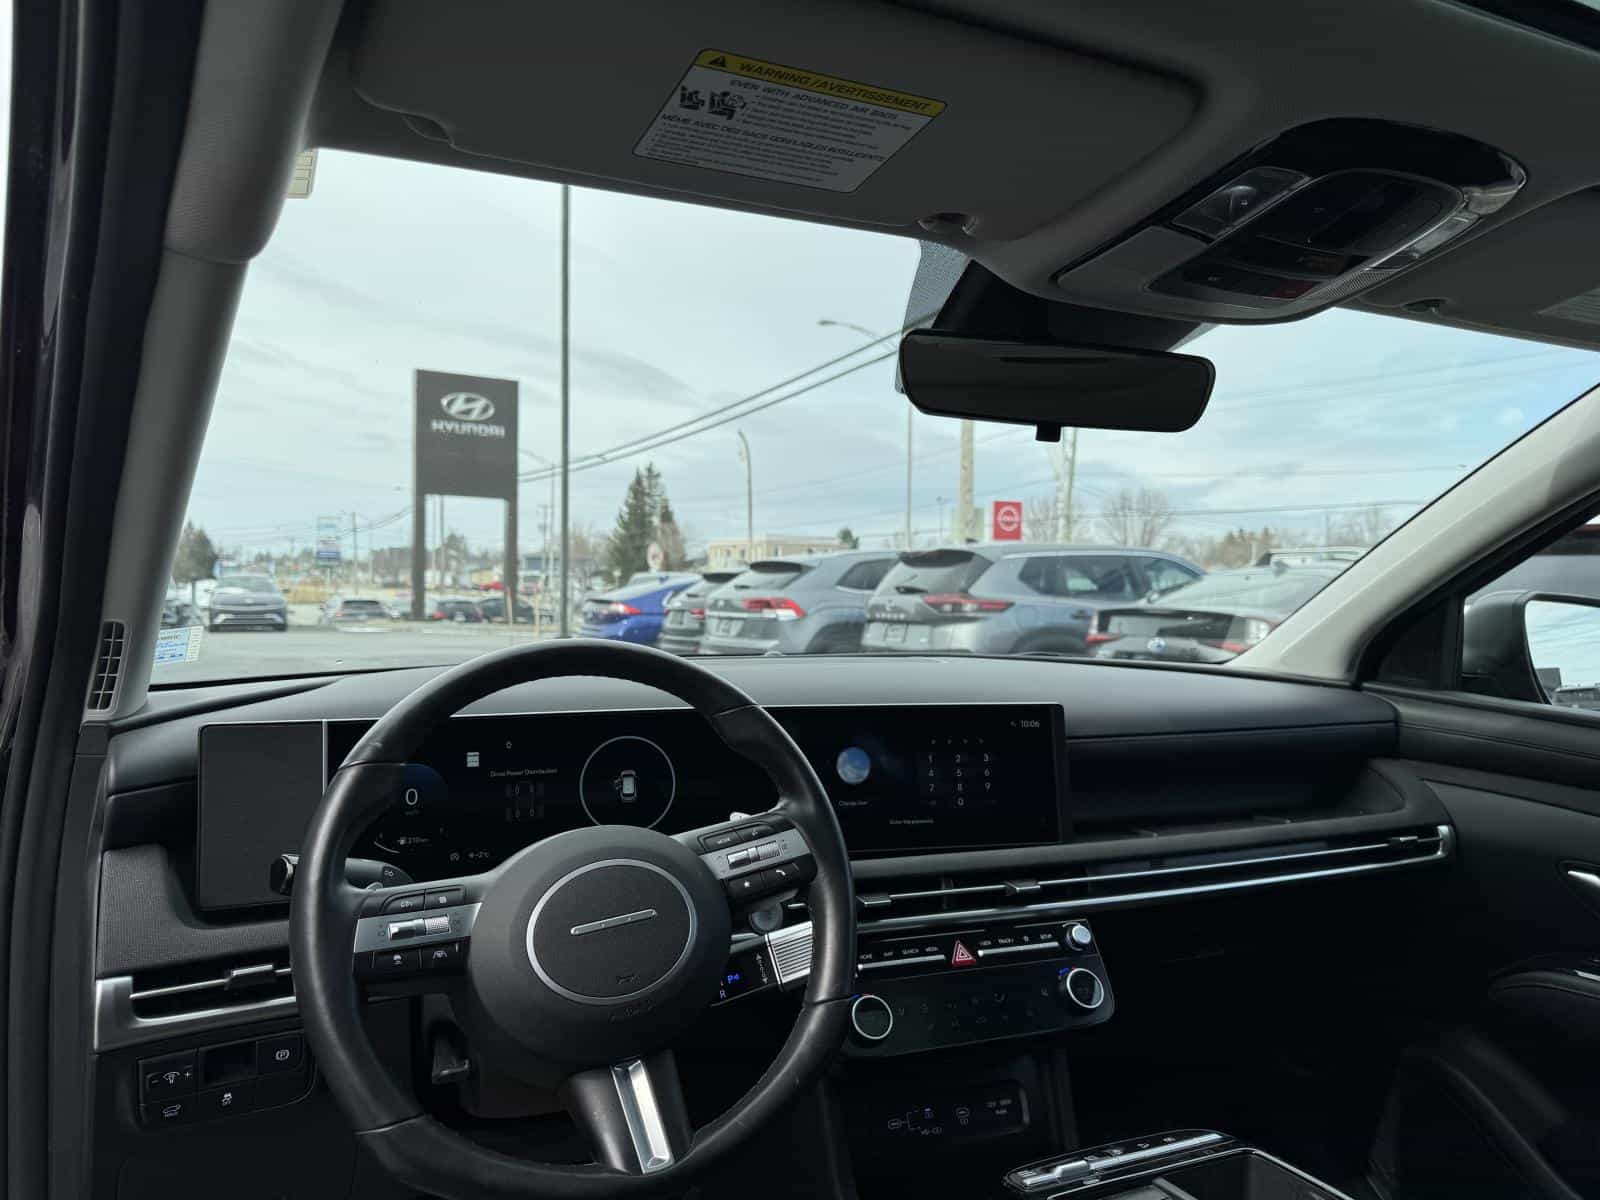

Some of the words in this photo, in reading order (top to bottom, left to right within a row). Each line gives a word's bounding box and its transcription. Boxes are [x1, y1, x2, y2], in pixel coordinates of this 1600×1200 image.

[738, 62, 811, 85] WARNING
[762, 84, 790, 99] WITH
[791, 92, 849, 111] ADVANCED
[691, 119, 719, 131] AVEC
[430, 418, 505, 438] HYUNDAI
[1020, 719, 1040, 729] 10:06
[404, 787, 419, 806] 0
[719, 989, 727, 1000] R
